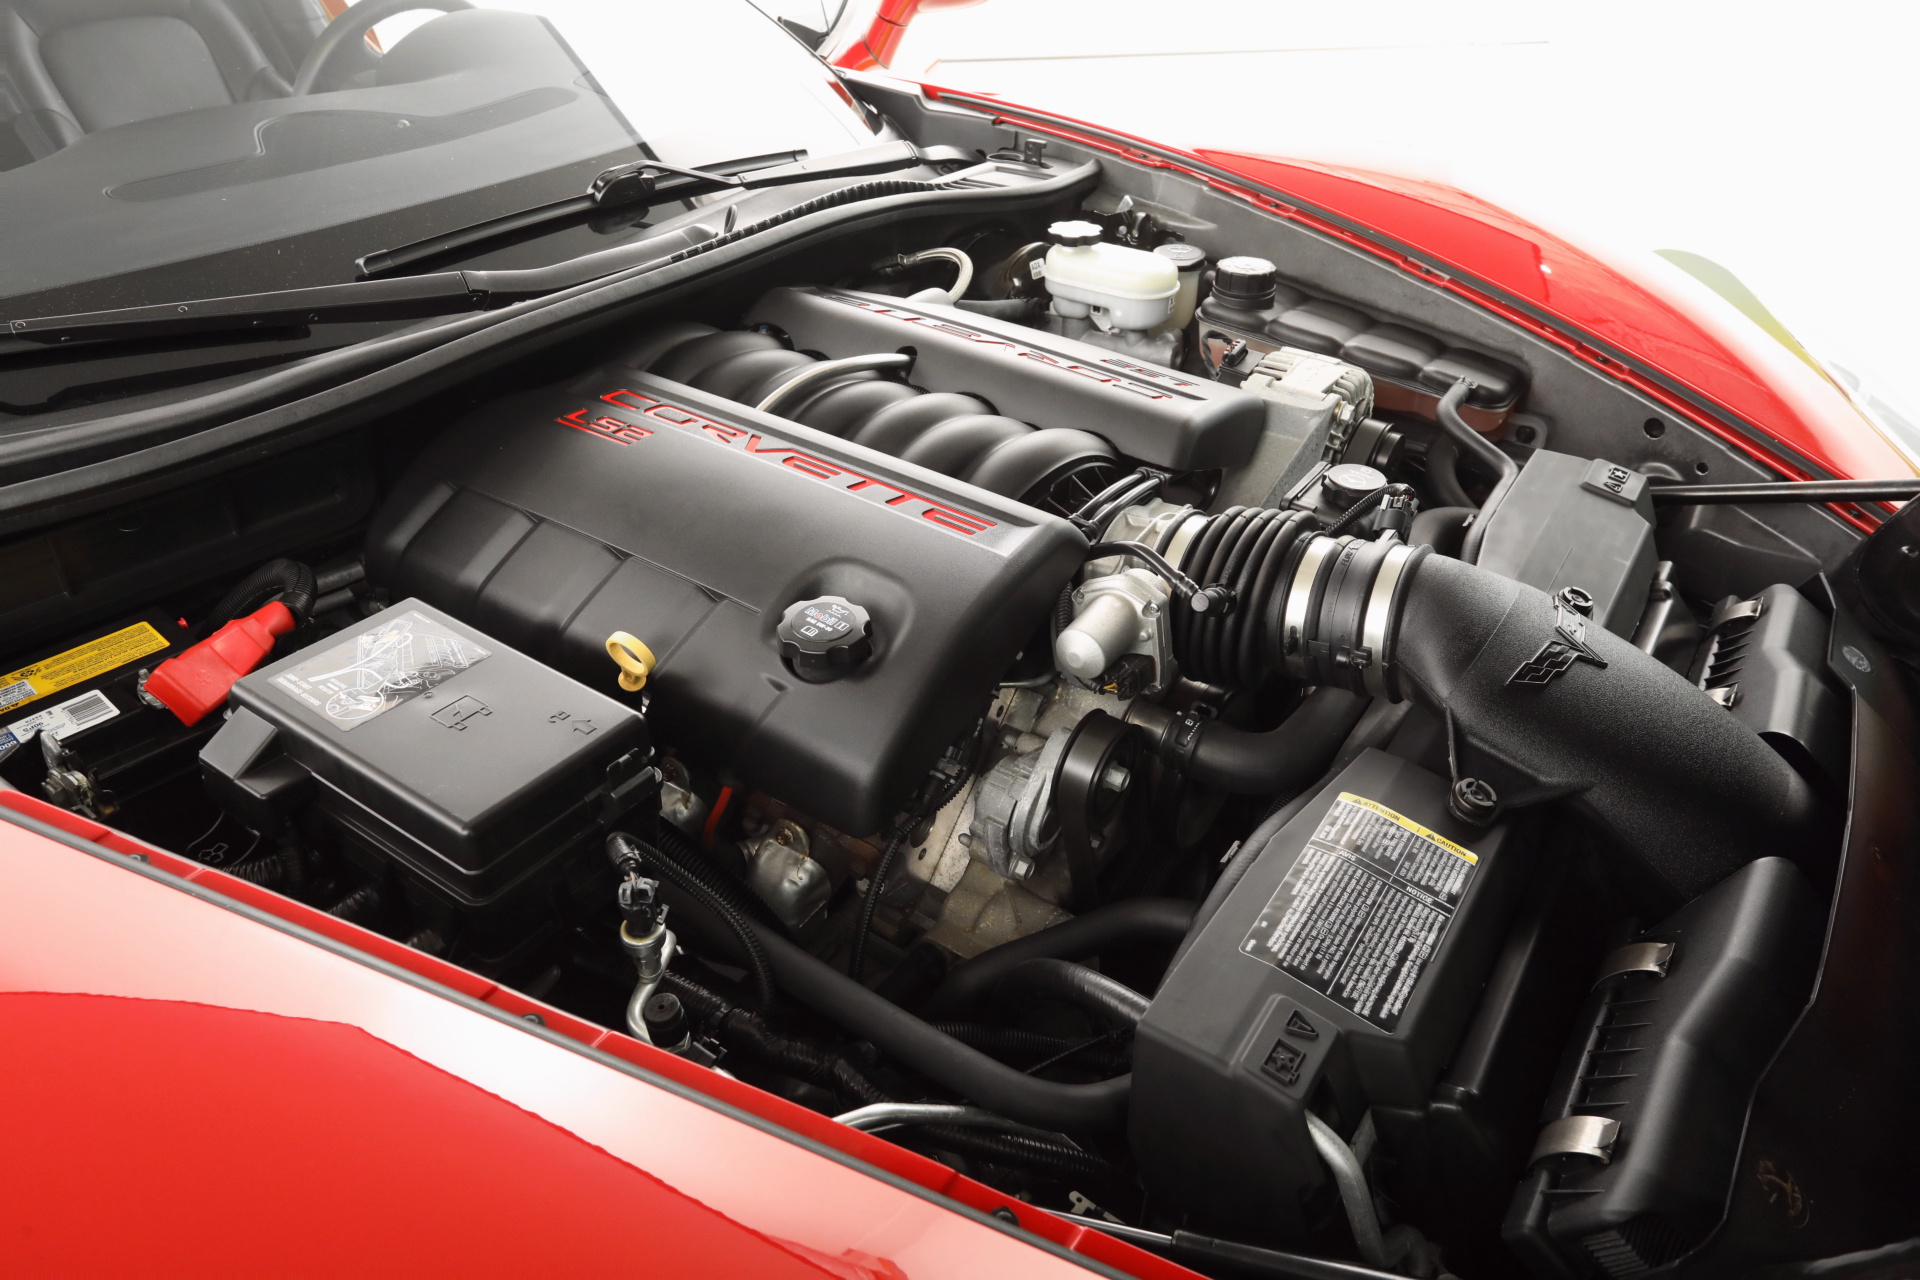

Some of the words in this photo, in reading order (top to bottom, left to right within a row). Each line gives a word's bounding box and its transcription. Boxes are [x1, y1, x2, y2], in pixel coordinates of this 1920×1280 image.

[556, 408, 655, 446] LS2
[600, 389, 998, 536] CORVETTE
[804, 606, 839, 626] Mobil
[1362, 800, 1401, 822] ATTENTION
[1338, 850, 1357, 862] AVIS
[1436, 838, 1467, 857] CAUTION
[1405, 886, 1434, 904] NOTICE
